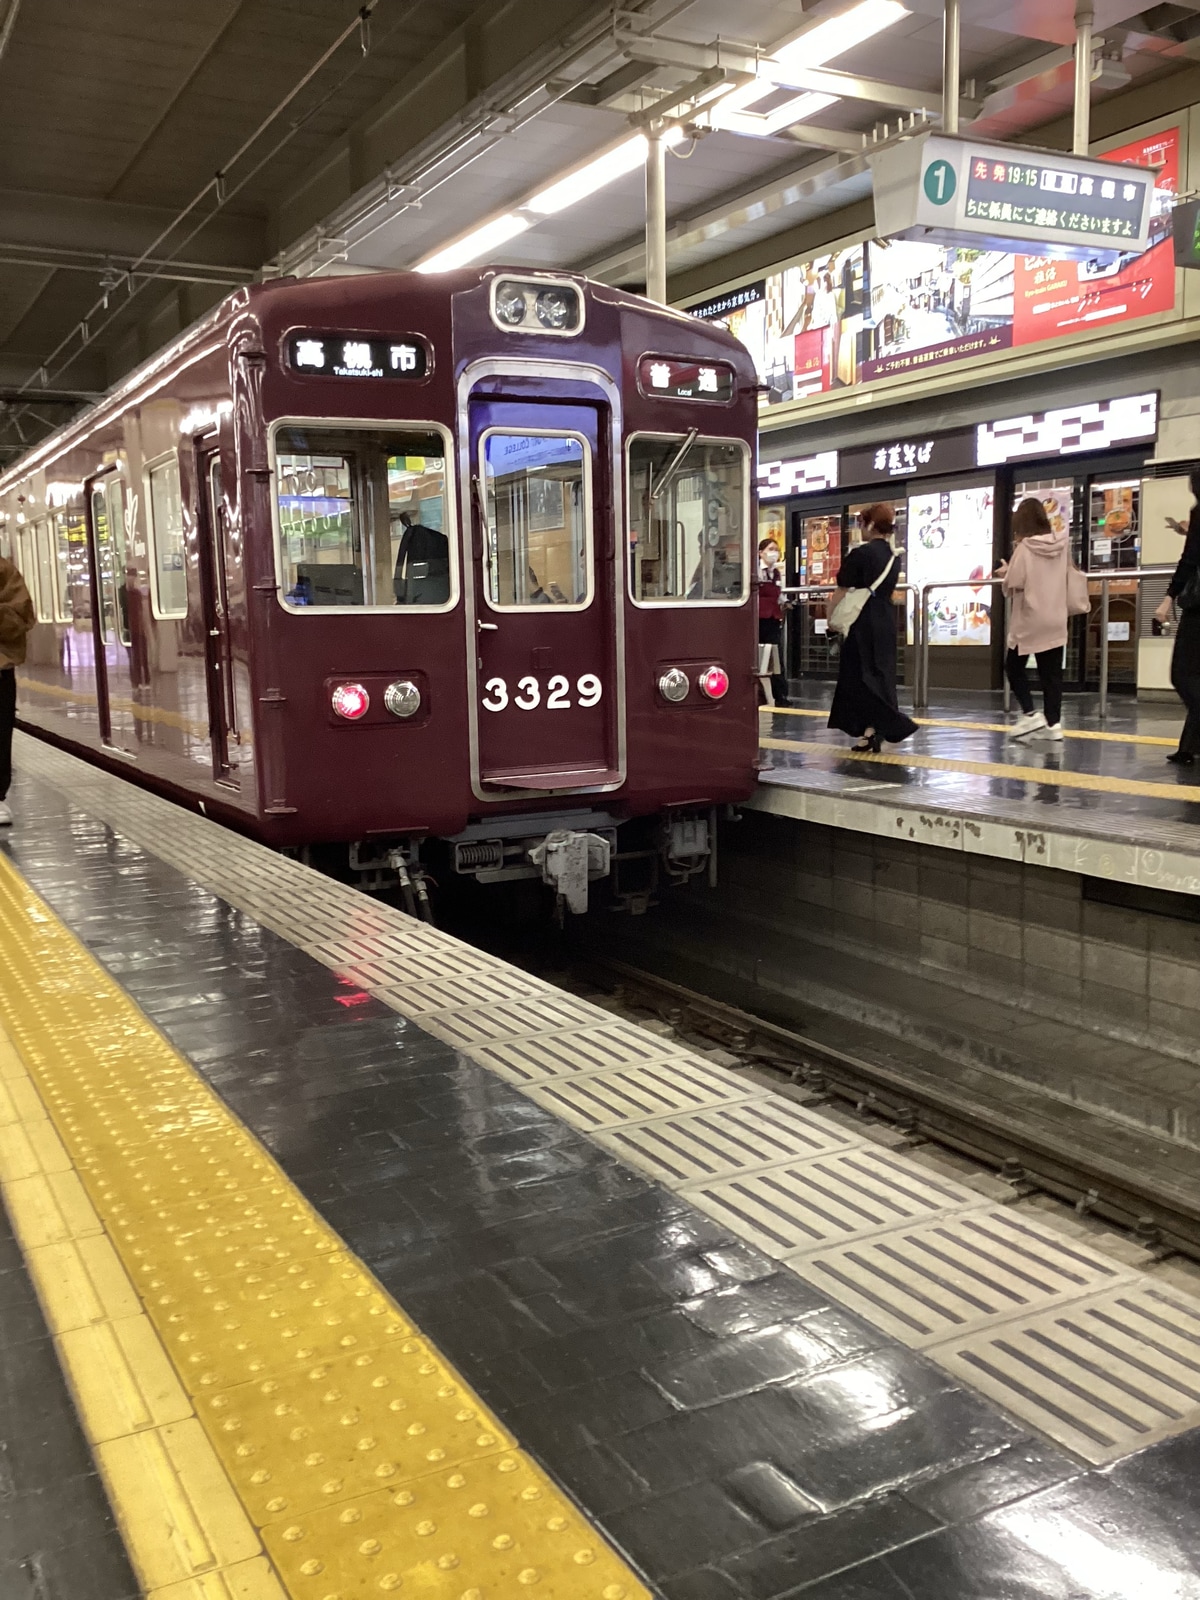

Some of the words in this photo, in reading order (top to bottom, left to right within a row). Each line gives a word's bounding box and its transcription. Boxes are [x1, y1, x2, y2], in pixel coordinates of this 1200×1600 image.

[934, 165, 946, 199] 1
[974, 161, 1006, 182] 先発
[1008, 166, 1038, 187] 19:15
[295, 339, 417, 372] 高槻市
[677, 387, 692, 397] Local
[481, 673, 603, 712] 3329
